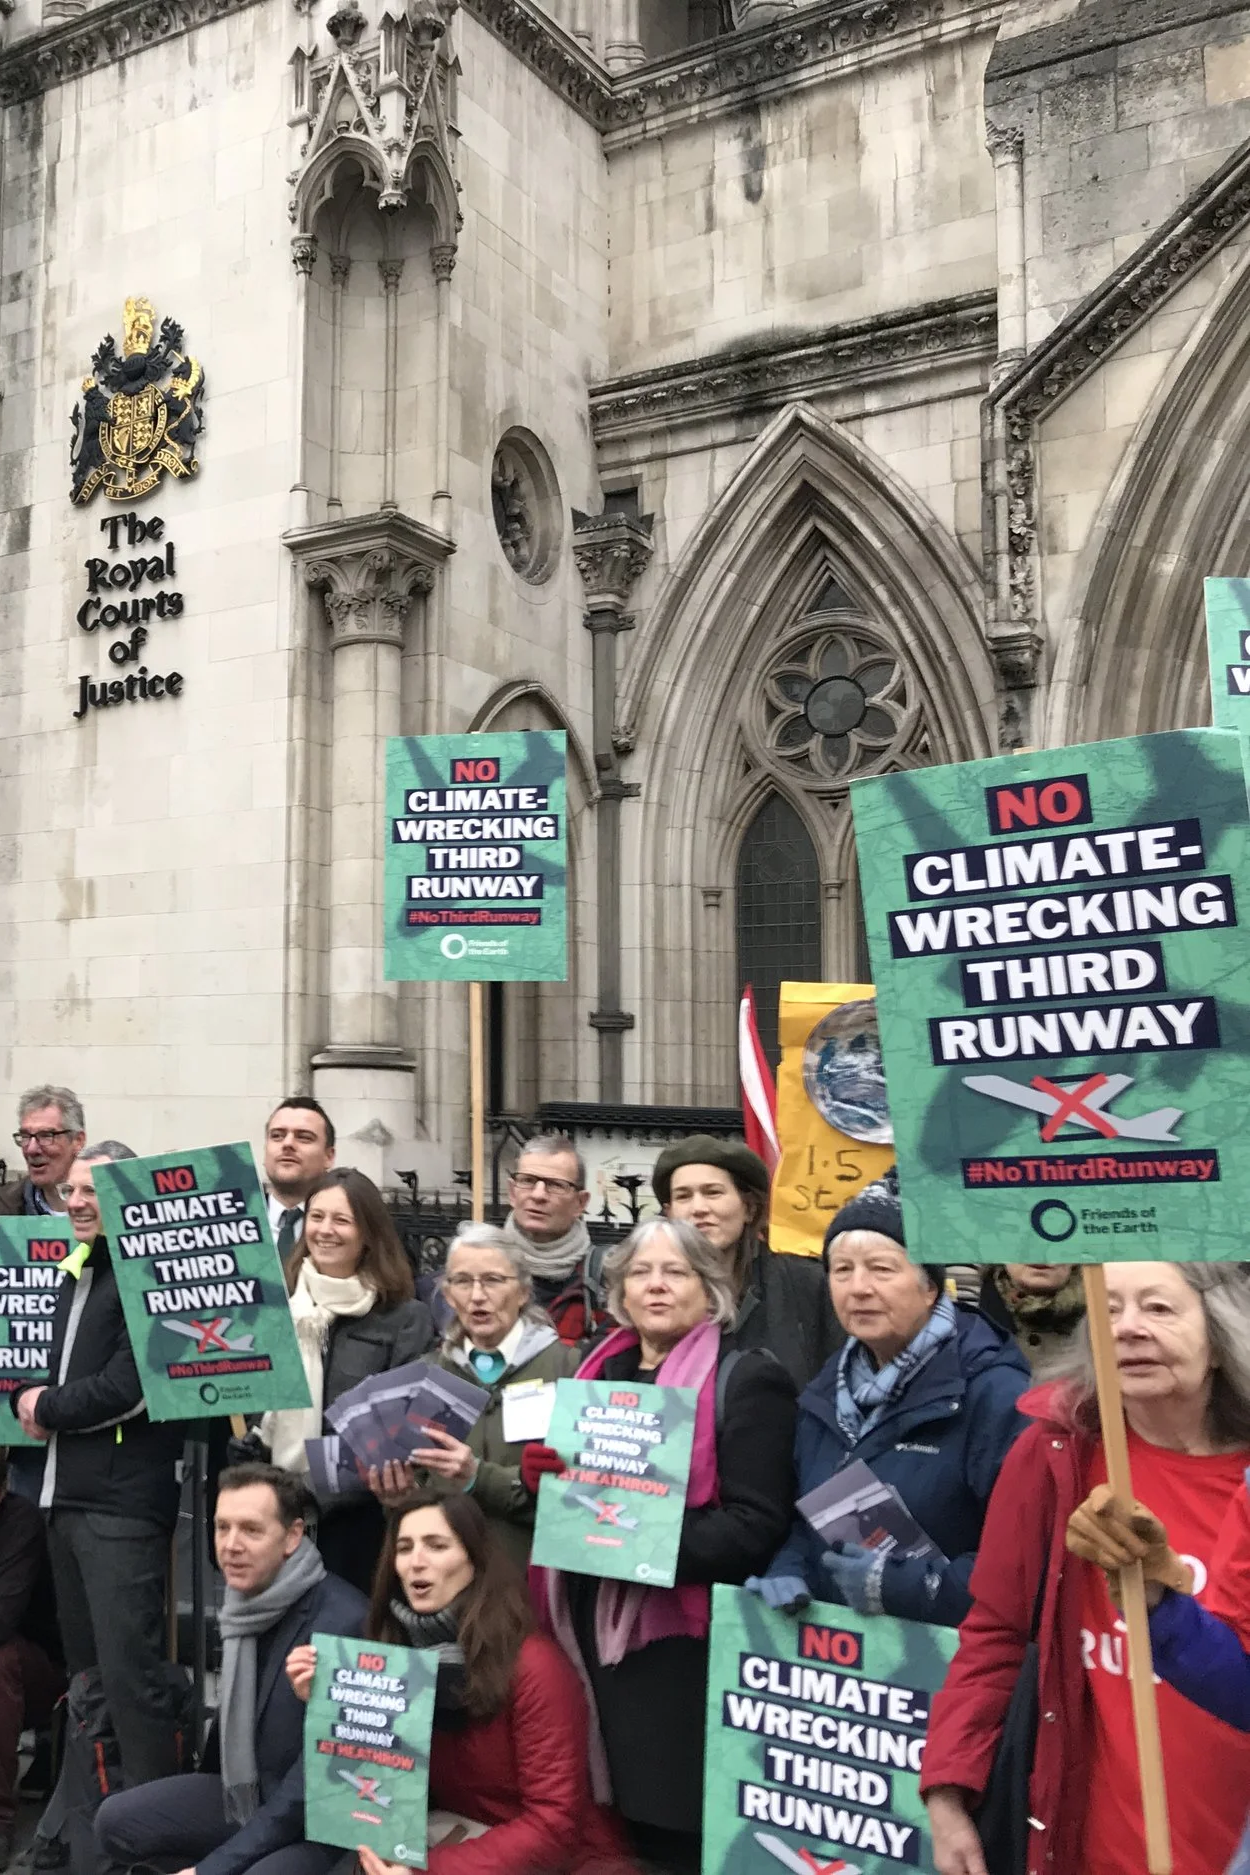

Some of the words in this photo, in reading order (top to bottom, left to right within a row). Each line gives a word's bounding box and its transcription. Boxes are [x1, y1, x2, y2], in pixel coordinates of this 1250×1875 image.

[156, 451, 185, 477] DROIT
[101, 511, 166, 550] The
[84, 541, 176, 593] Royal
[76, 587, 184, 632] Courts
[108, 626, 148, 665] of
[73, 666, 185, 719] Justice
[454, 760, 497, 782] NO
[408, 788, 549, 812] CLIMATE-
[995, 781, 1084, 830] NO
[396, 816, 556, 841] WRECKING
[429, 847, 521, 869] THIRD
[911, 826, 1203, 896] CLIMATE-
[410, 875, 540, 898] RUNWAY
[409, 910, 540, 925] #NoThirdRunway
[894, 882, 1228, 953] WRECKING
[965, 948, 1158, 1002] THIRD
[937, 1001, 1205, 1061] RUNWAY
[155, 1167, 195, 1194] NO
[965, 1156, 1214, 1184] #NoThirdRunway
[123, 1192, 246, 1229] CLIMATE-
[1080, 1207, 1139, 1220] Friends
[1140, 1206, 1157, 1218] of
[120, 1219, 260, 1258] WRECKING
[1082, 1223, 1110, 1235] the
[1111, 1221, 1159, 1234] Earth
[31, 1240, 67, 1260] NO
[154, 1253, 236, 1283] THIRD
[146, 1280, 257, 1315] RUNWAY
[10, 1320, 53, 1342] THI
[610, 1391, 639, 1407] NO
[585, 1406, 660, 1427] CLIMATE-
[577, 1421, 662, 1445] WRECKING
[592, 1437, 642, 1457] THIRD
[579, 1453, 650, 1476] RUNWAY
[578, 1470, 671, 1497] HEATHROW
[802, 1625, 860, 1666] NO
[357, 1653, 385, 1671] NO
[335, 1668, 405, 1693] CLIMATE-
[742, 1656, 929, 1724] CLIMATE-
[329, 1685, 406, 1712] WRECKING
[343, 1707, 388, 1728] THIRD
[334, 1725, 396, 1749] RUNWAY
[337, 1743, 415, 1771] HEATHROW
[767, 1746, 889, 1807] THIRD
[743, 1784, 914, 1859] RUNWAY
